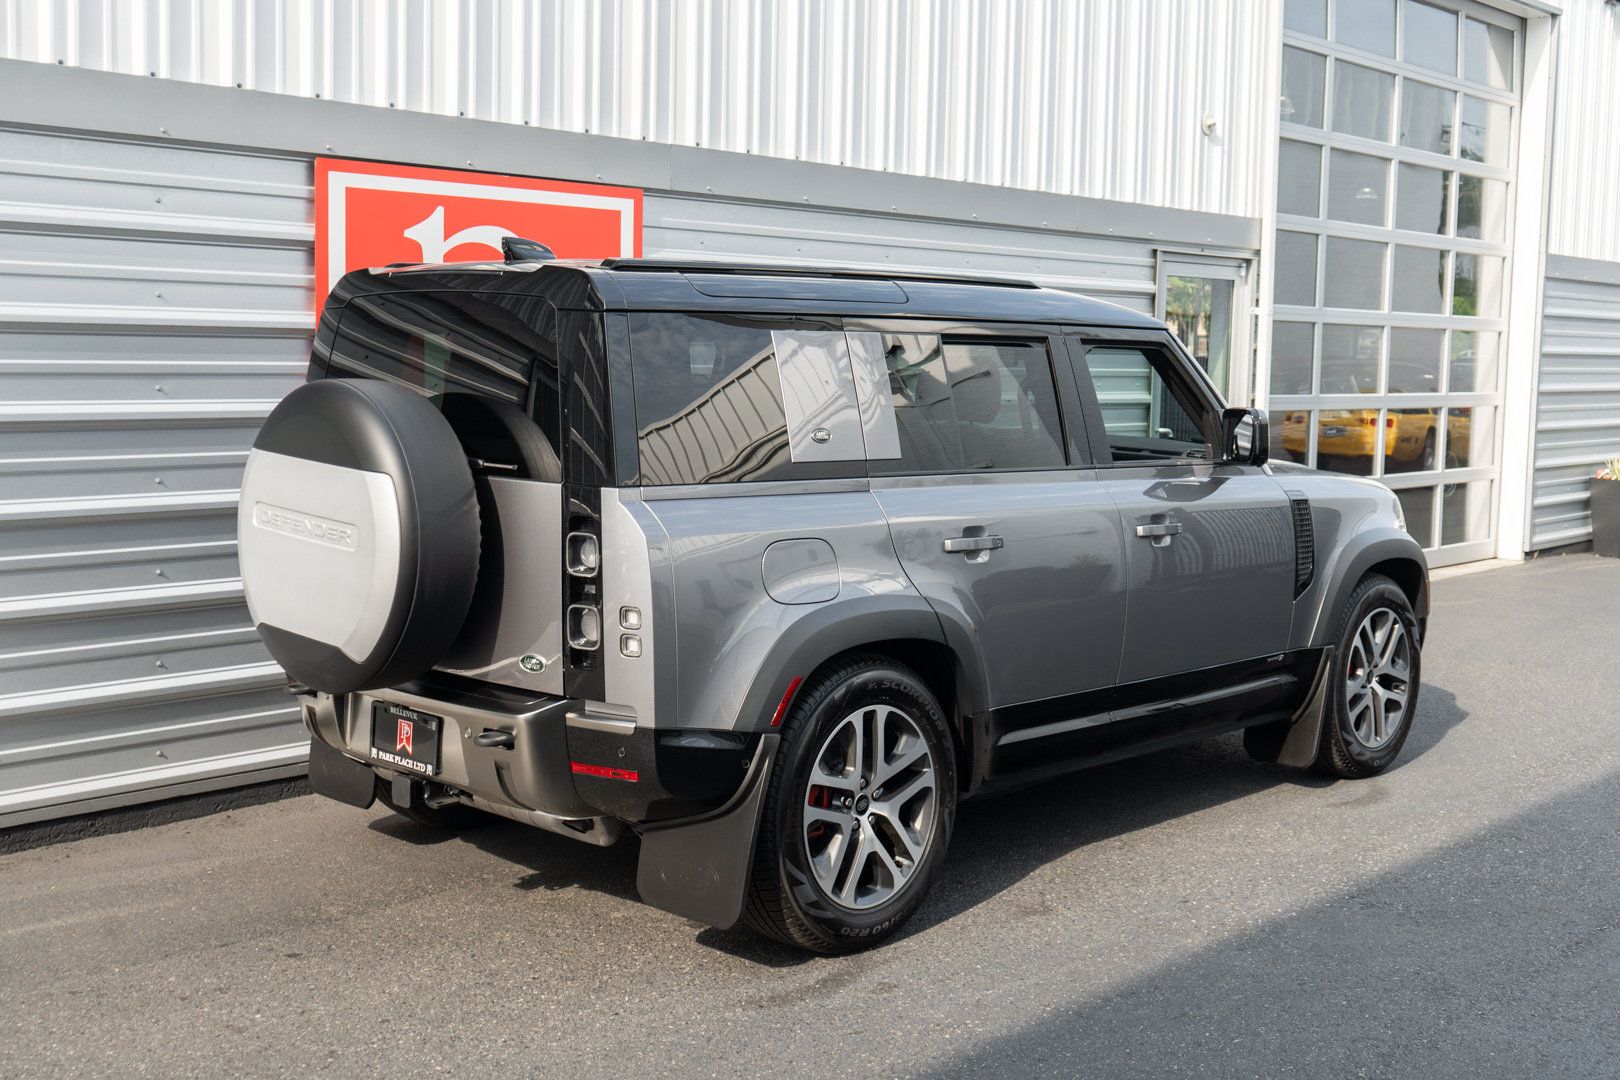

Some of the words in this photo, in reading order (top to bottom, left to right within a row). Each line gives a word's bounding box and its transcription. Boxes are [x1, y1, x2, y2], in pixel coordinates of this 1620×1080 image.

[260, 509, 352, 544] DEFENDER
[389, 706, 419, 720] BELLEVUE
[378, 750, 395, 763] PARK
[394, 755, 413, 769] PLACE
[413, 761, 426, 772] LTD
